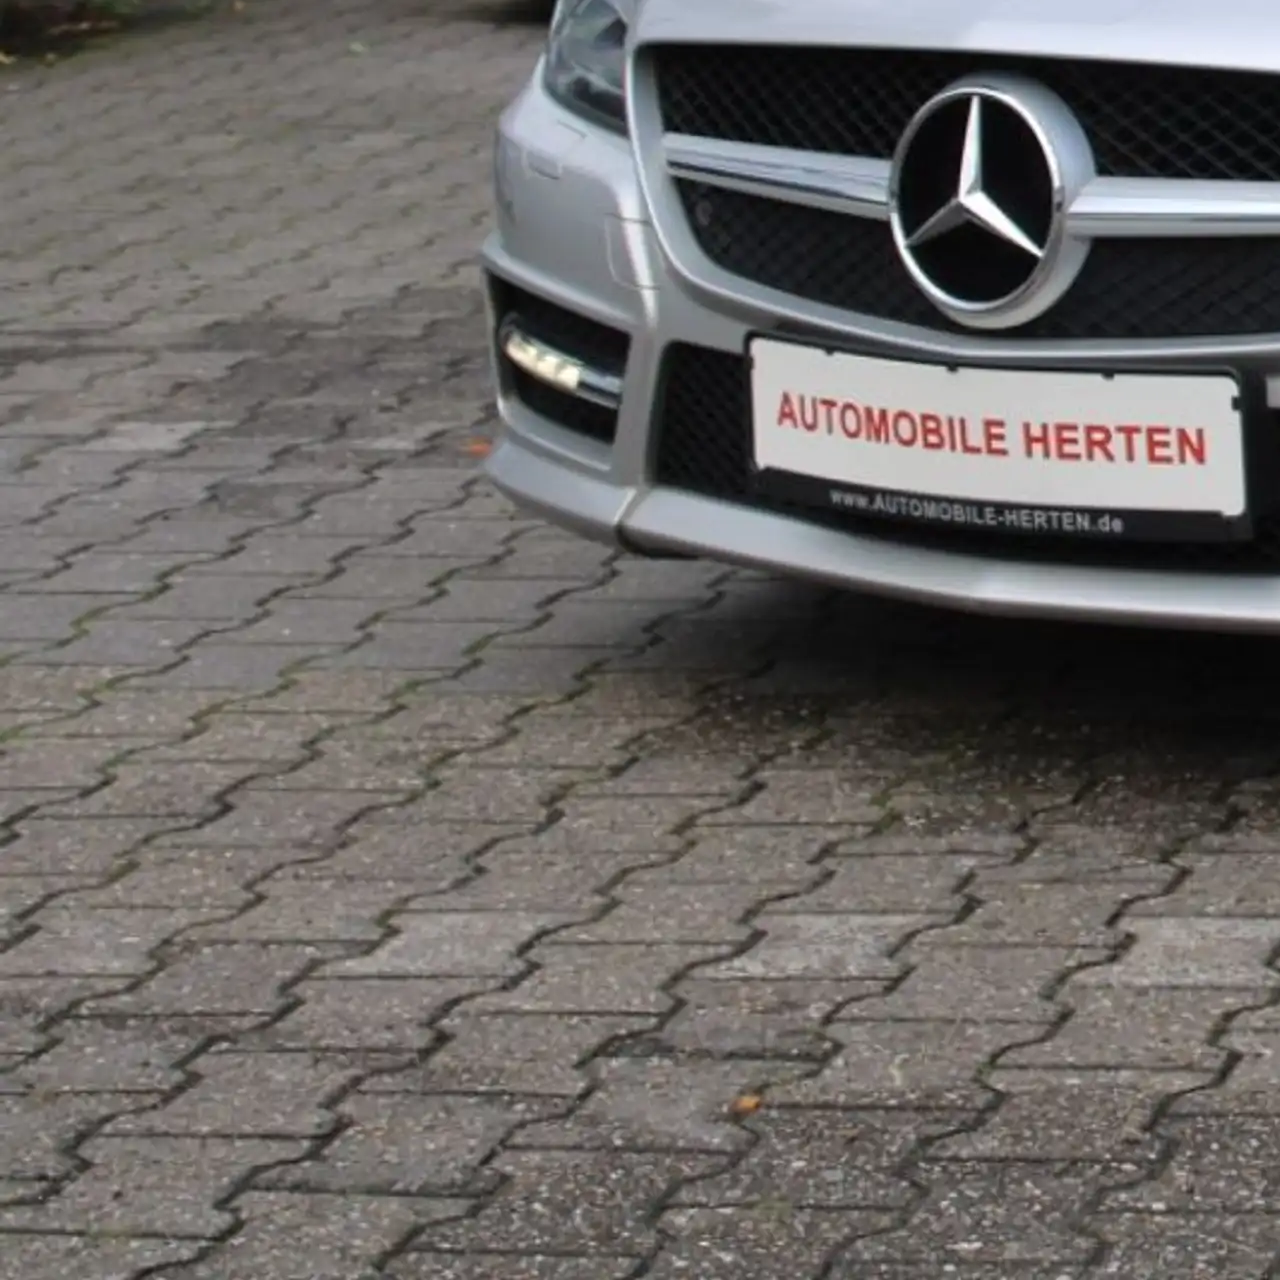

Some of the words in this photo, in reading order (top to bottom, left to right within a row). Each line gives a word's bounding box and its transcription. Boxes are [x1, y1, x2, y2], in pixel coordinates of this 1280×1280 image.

[777, 391, 1009, 456] AUTOMOBILE
[1022, 421, 1207, 465] HERTEN
[829, 488, 1124, 533] www.AUTOMOBILE-HERTEN.de
